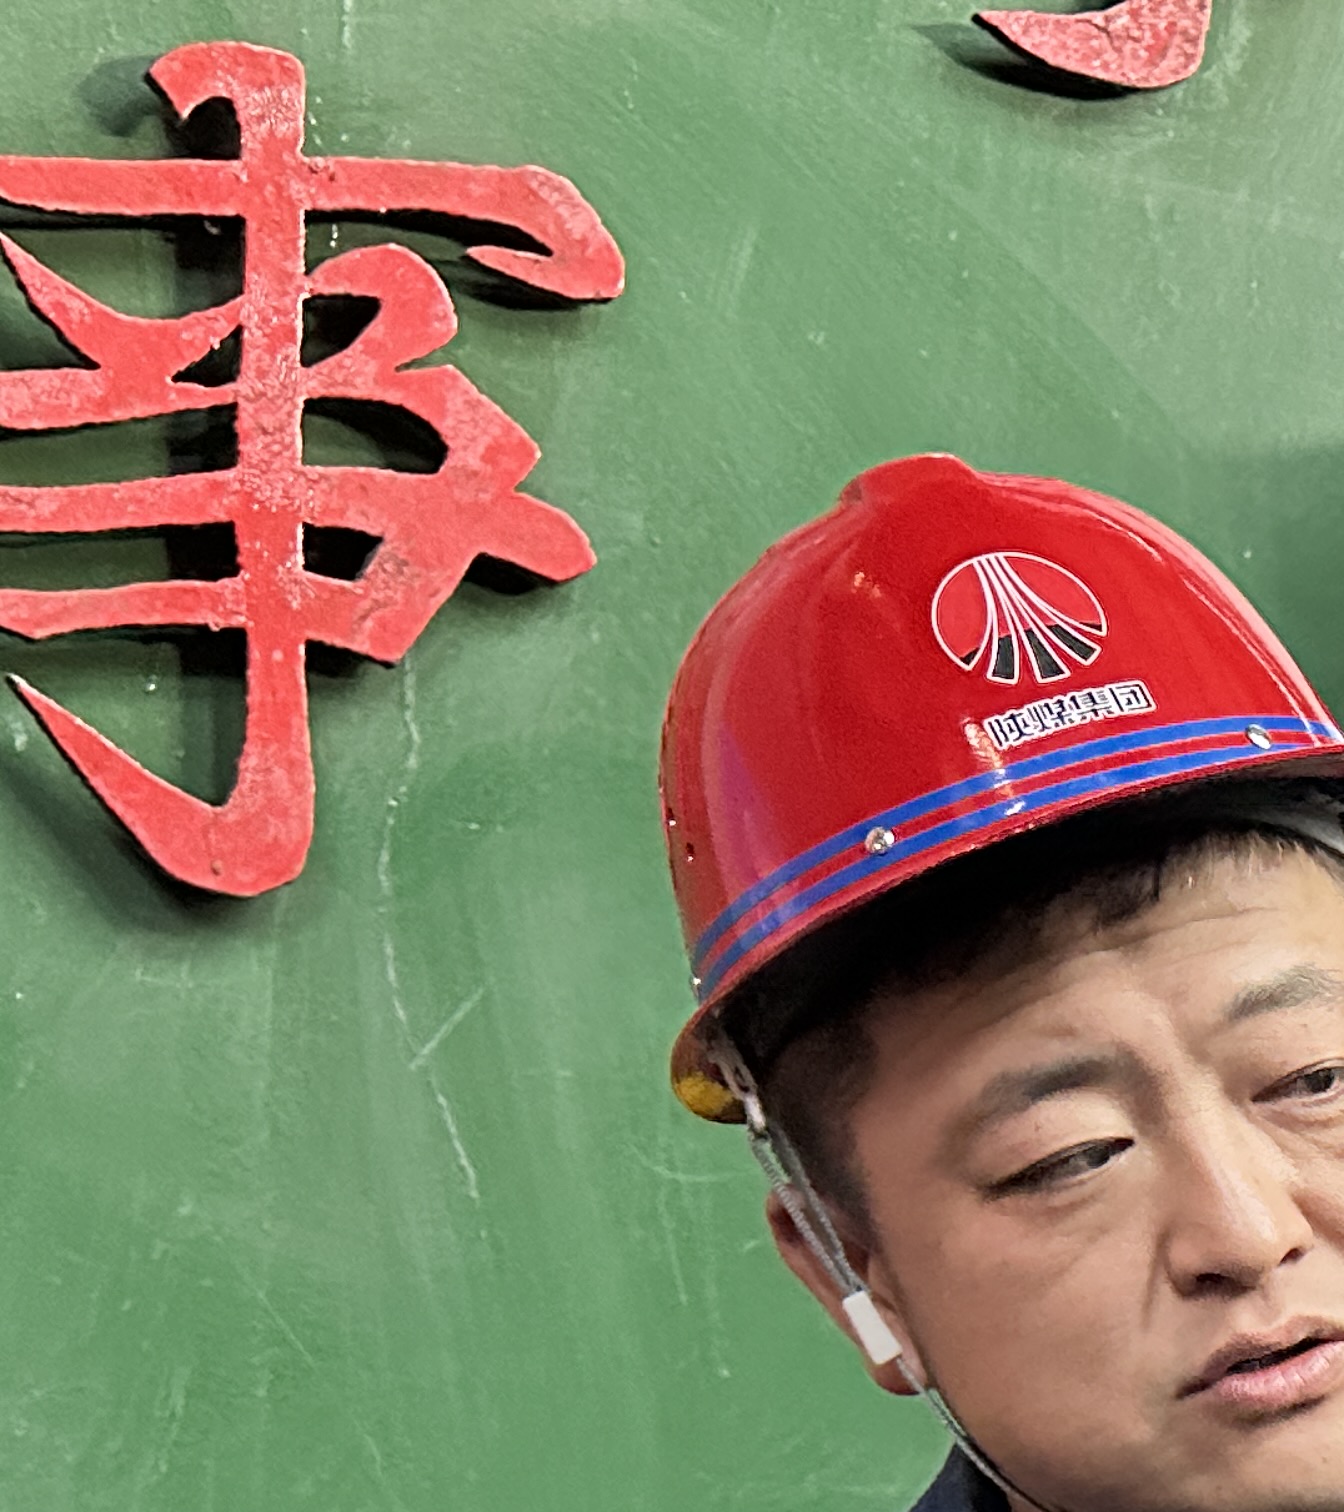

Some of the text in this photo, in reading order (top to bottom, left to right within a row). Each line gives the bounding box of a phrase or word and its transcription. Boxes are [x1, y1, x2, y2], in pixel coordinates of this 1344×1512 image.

[0, 41, 625, 897] 事
[985, 681, 1155, 749] 陕煤集团
